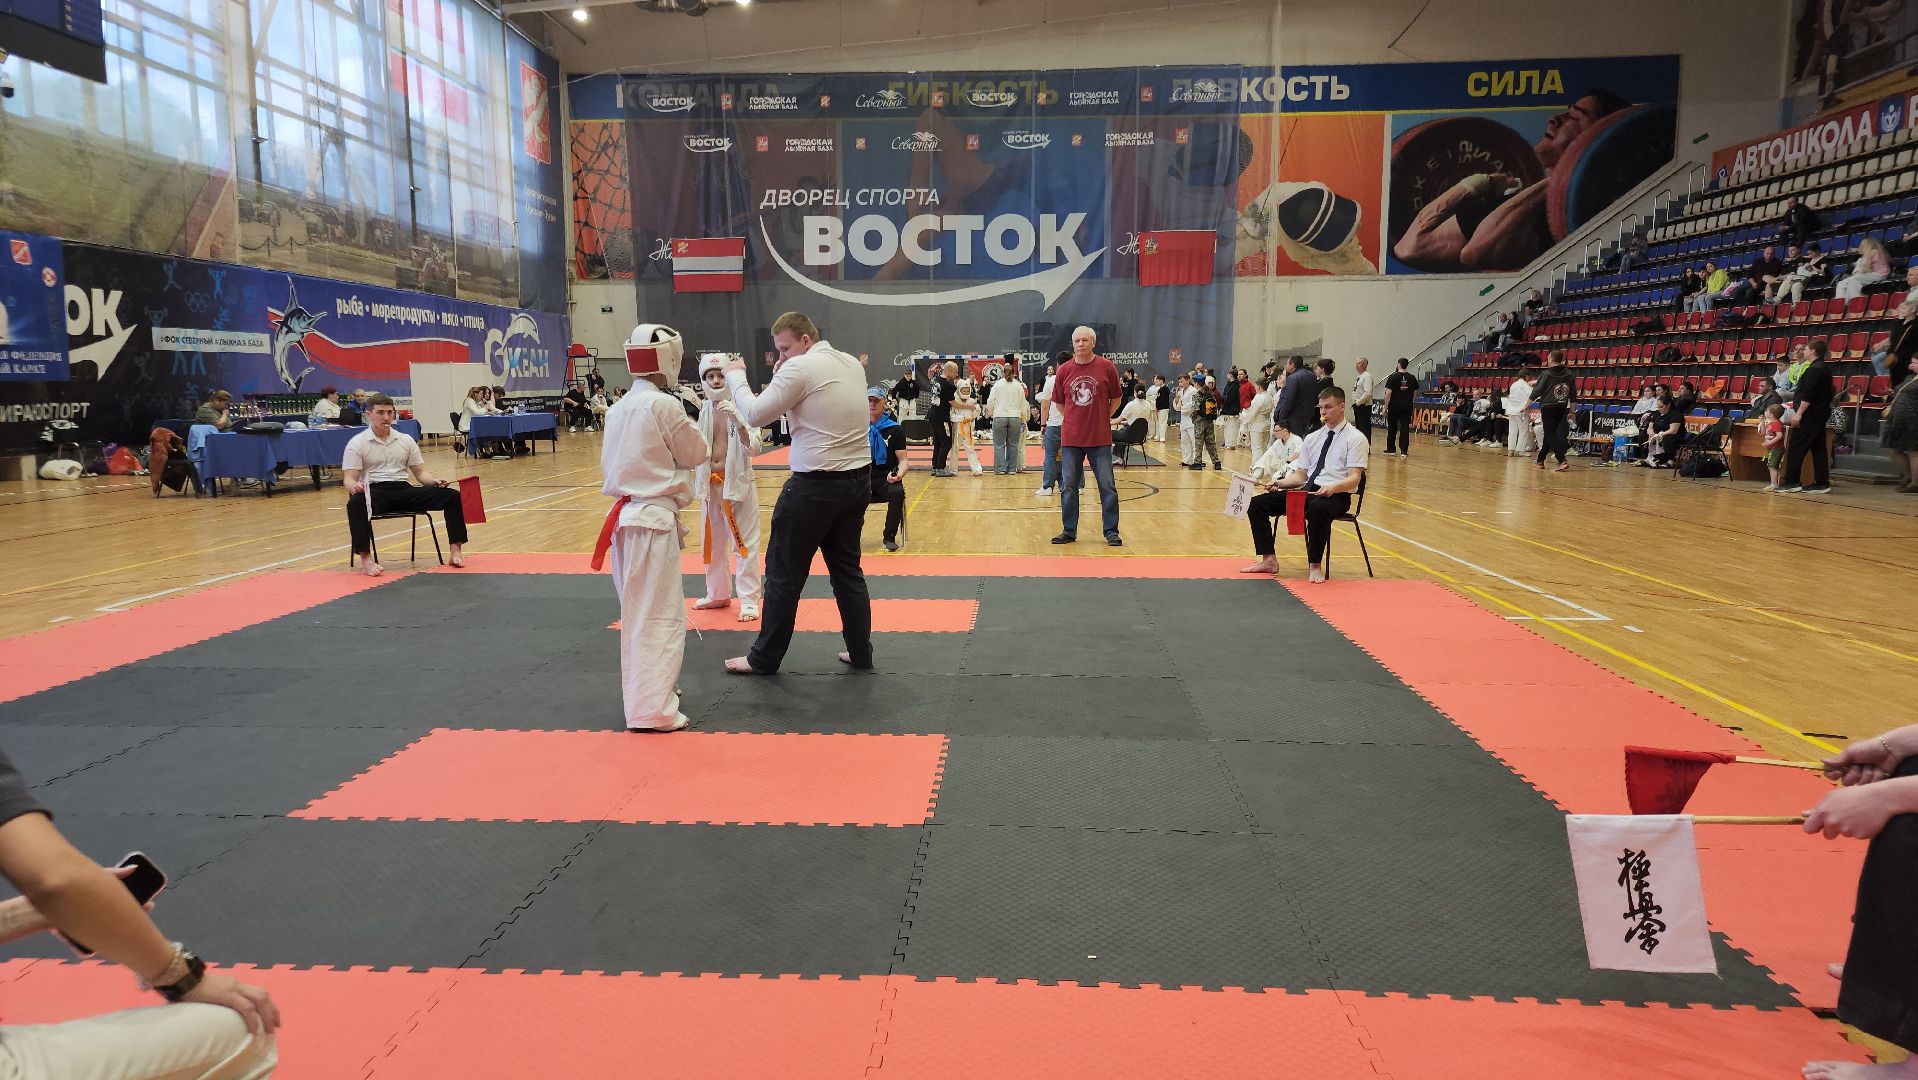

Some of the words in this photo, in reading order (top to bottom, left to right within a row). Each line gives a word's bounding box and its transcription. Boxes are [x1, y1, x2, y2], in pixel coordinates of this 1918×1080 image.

[1467, 69, 1564, 97] СИЛА
[652, 97, 694, 106] ВОСТОК
[972, 92, 1015, 102] ВОСТОК
[689, 138, 731, 147] ВОСТОК
[1007, 134, 1050, 144] ВОСТОК
[1732, 110, 1873, 176] АВТОШКОЛА
[759, 189, 850, 210] ДВОРЕЦ
[855, 188, 940, 206] СПОРТА
[803, 213, 1088, 266] ВОСТОК
[336, 295, 364, 318] рыба
[371, 302, 436, 326] морепродукты
[442, 311, 459, 327] мясо
[464, 316, 485, 331] птица
